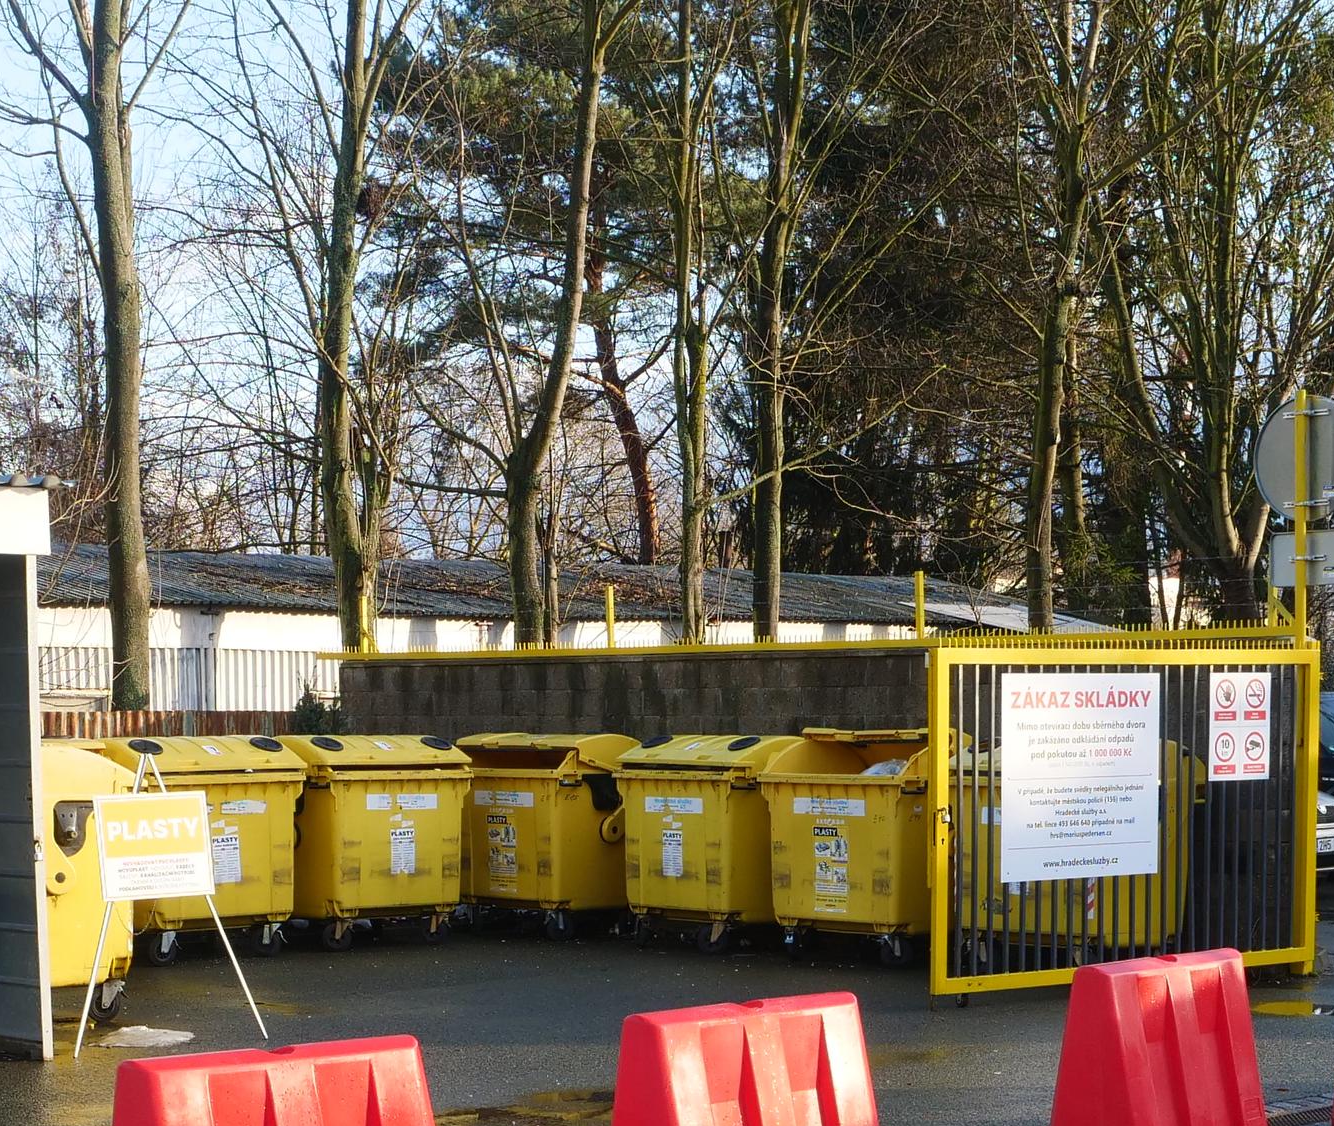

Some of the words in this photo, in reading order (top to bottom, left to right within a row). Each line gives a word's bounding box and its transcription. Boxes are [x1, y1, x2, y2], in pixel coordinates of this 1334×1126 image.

[1010, 686, 1070, 709] ZÁKAZ
[1074, 686, 1151, 708] SKLÁDKY
[1072, 720, 1091, 729] dobu
[1126, 720, 1146, 729] dvora
[1221, 739, 1230, 749] 10
[1030, 750, 1045, 760] pod
[1047, 749, 1077, 760] pokutou
[107, 817, 199, 842] PLASTY
[814, 828, 836, 836] PLASTY
[1043, 856, 1118, 869] www.hradeckesluzby.cz
